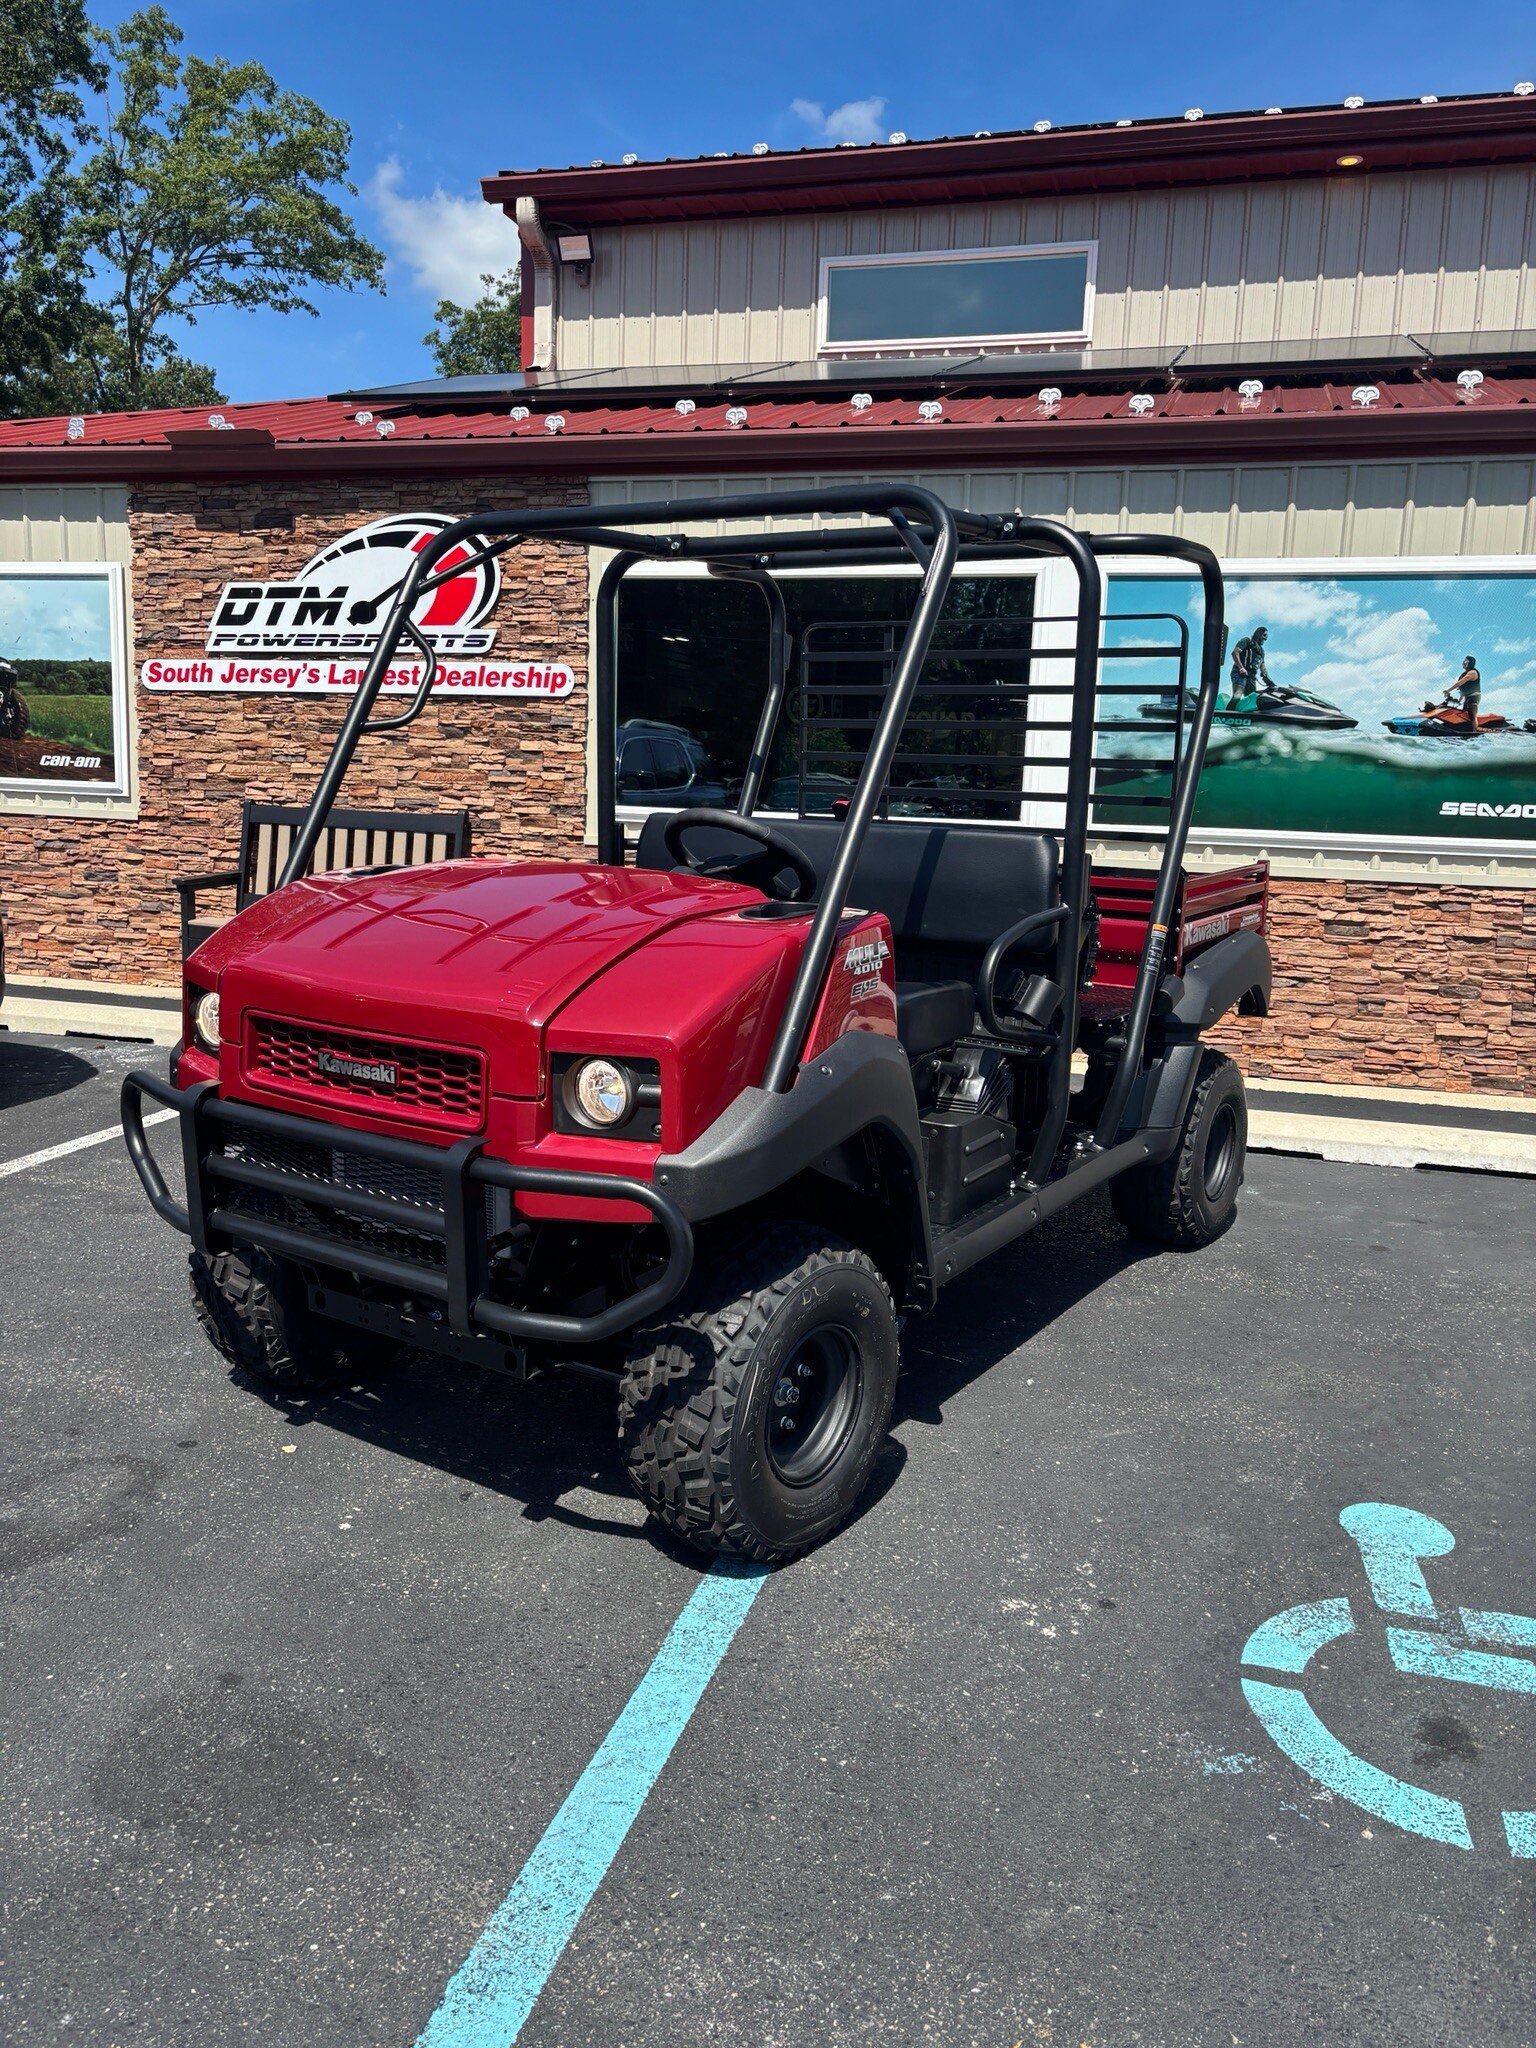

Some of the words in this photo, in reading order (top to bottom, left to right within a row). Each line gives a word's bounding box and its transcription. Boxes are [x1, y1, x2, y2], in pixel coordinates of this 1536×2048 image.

[216, 586, 349, 626] DTM
[148, 662, 213, 683] South
[220, 663, 320, 689] Jersey's
[328, 664, 421, 686] Larest
[433, 665, 567, 694] Dealership
[40, 754, 101, 769] can-am
[1184, 915, 1230, 945] Kawasaki
[843, 940, 891, 971] MULE
[853, 961, 883, 976] 4010
[851, 978, 879, 998] EPS
[317, 1053, 396, 1085] Kawasaki
